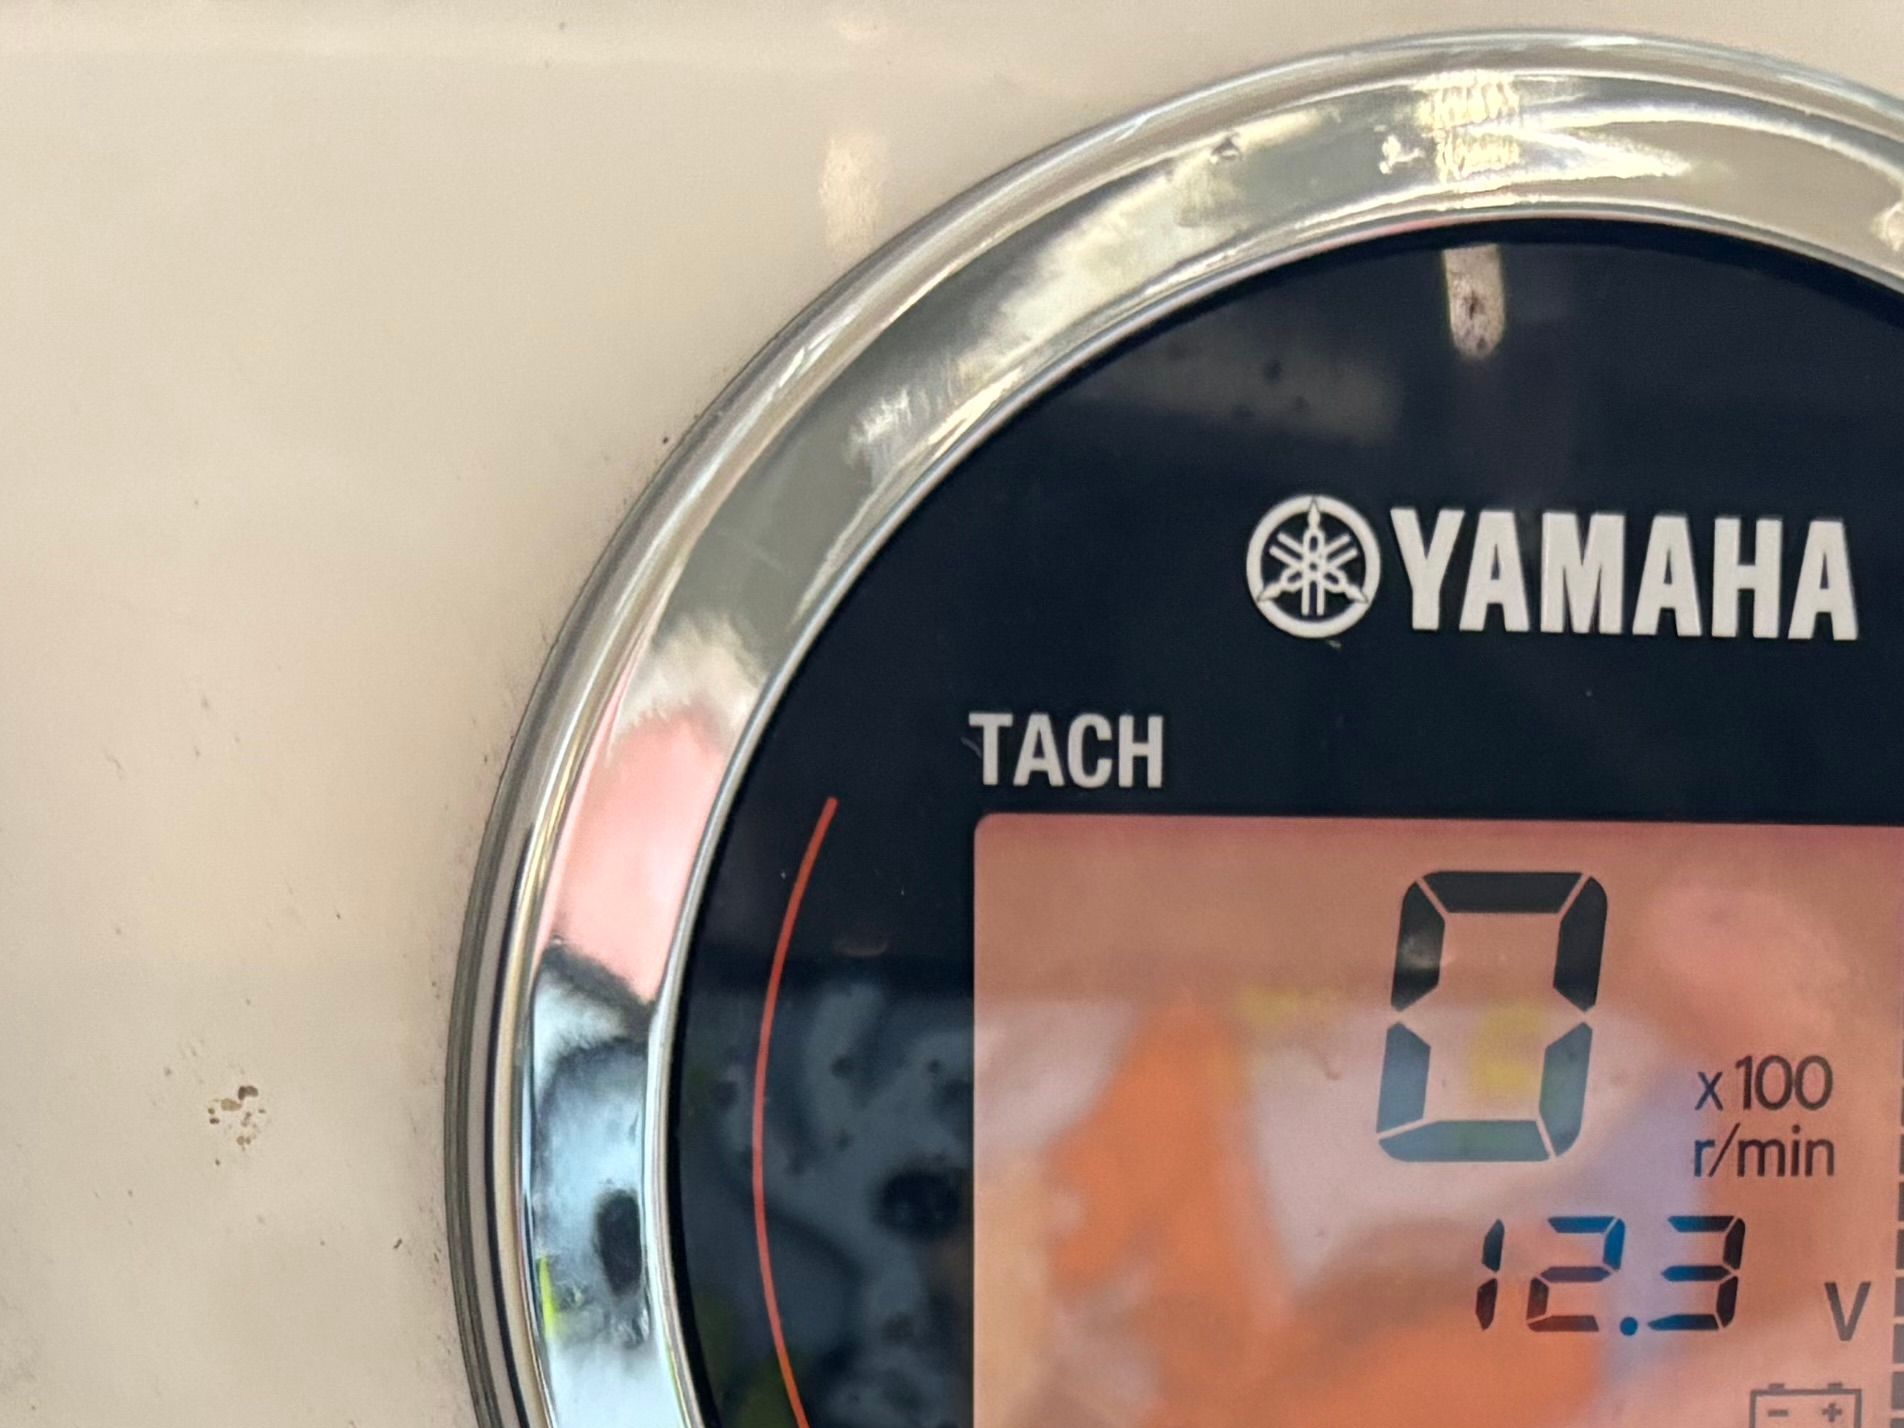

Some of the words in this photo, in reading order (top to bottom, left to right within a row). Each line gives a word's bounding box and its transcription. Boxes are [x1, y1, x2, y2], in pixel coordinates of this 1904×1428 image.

[1390, 507, 1859, 642] YAMAHA
[968, 712, 1164, 789] TACH
[1376, 869, 1609, 1163] 0
[1694, 1053, 1835, 1112] x100
[1692, 1120, 1837, 1179] r/min
[1474, 1213, 1748, 1337] 12.3
[1823, 1280, 1873, 1343] V
